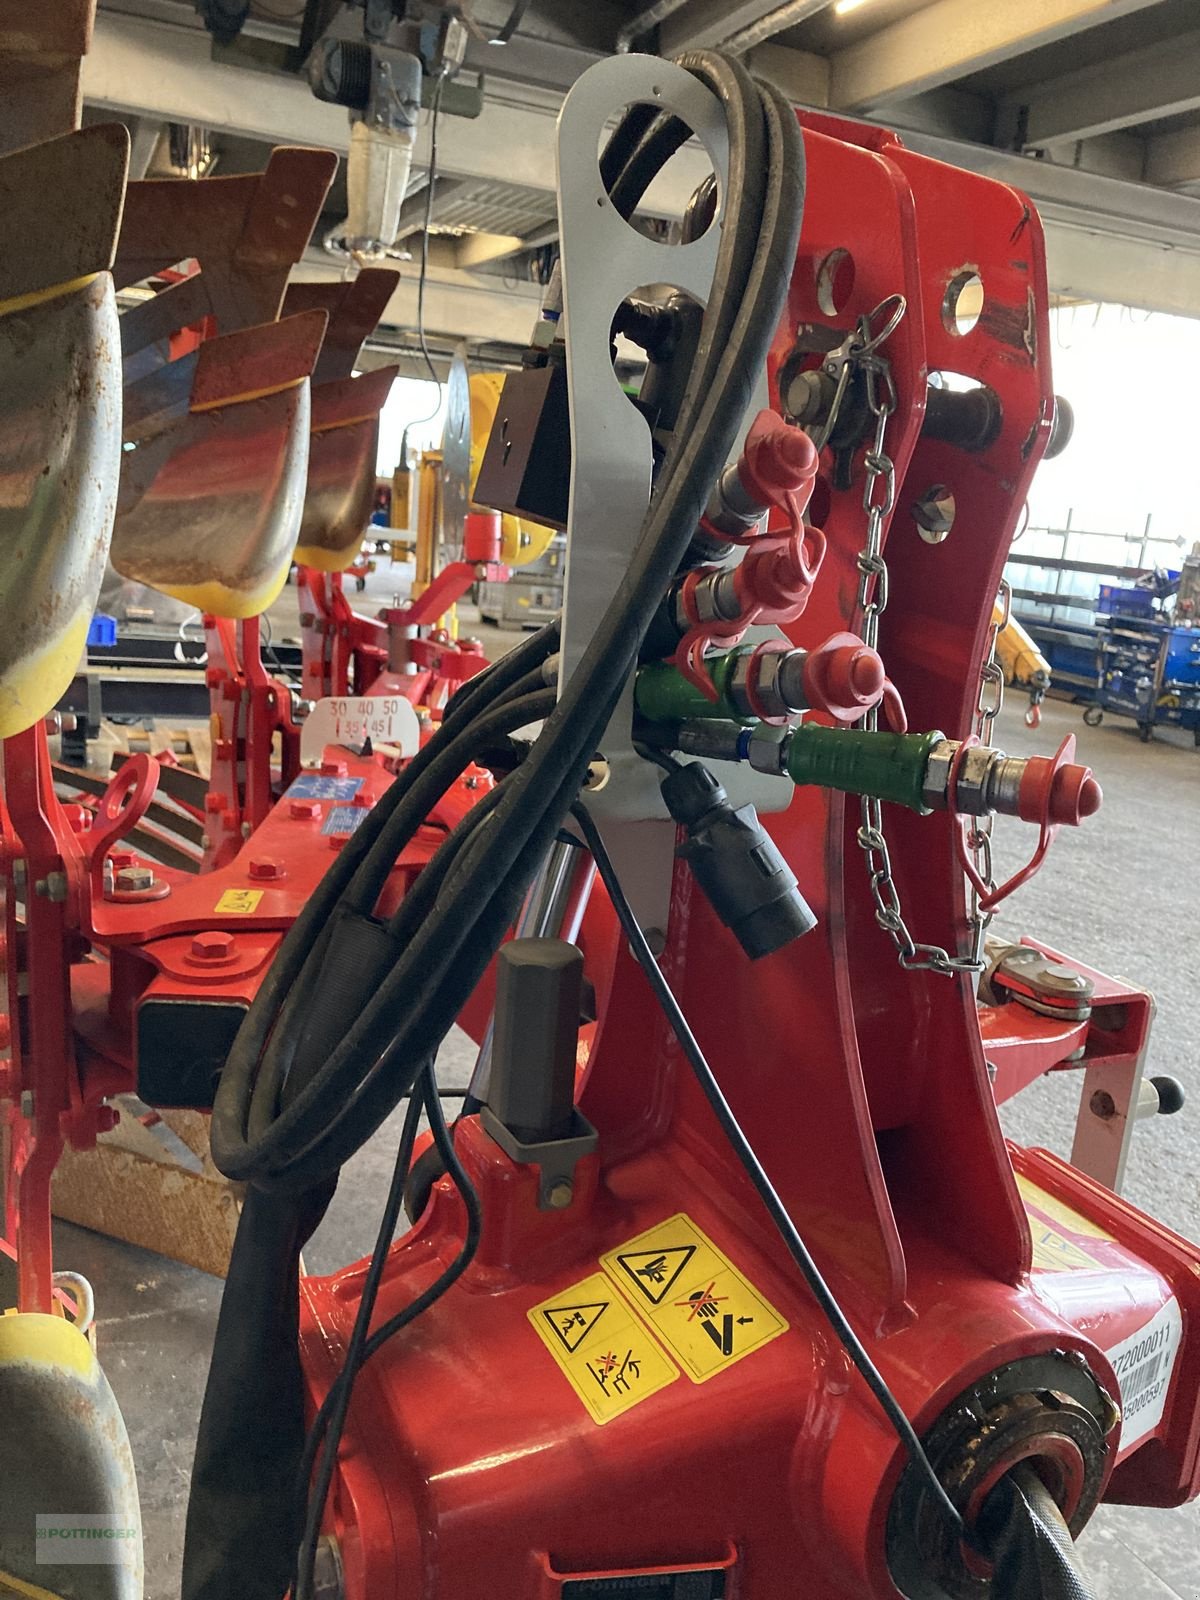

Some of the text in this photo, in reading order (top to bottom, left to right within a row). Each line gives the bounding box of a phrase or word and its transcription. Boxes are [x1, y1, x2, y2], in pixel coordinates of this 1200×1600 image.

[330, 700, 399, 716] 30 40 50
[371, 720, 385, 733] 45
